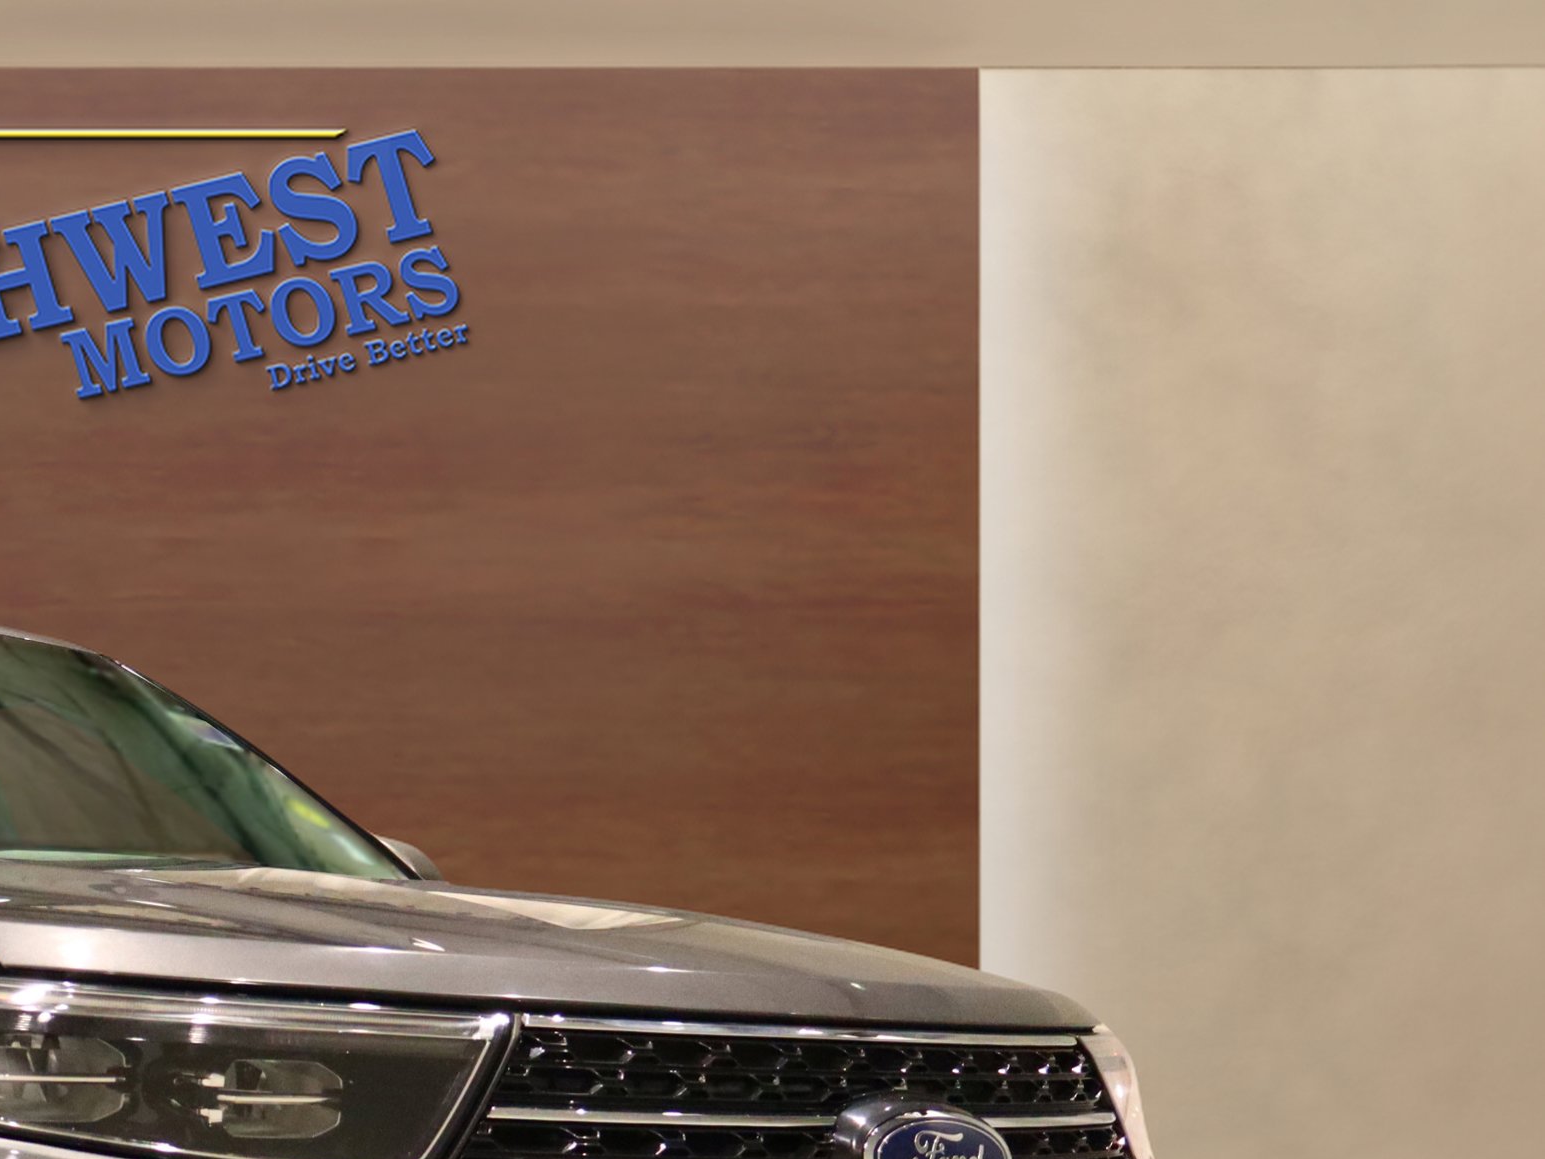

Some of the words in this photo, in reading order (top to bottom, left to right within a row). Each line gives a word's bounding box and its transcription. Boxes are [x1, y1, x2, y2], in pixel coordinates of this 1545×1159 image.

[60, 246, 461, 399] MOTORS
[266, 350, 357, 391] Drive
[366, 323, 469, 367] Better
